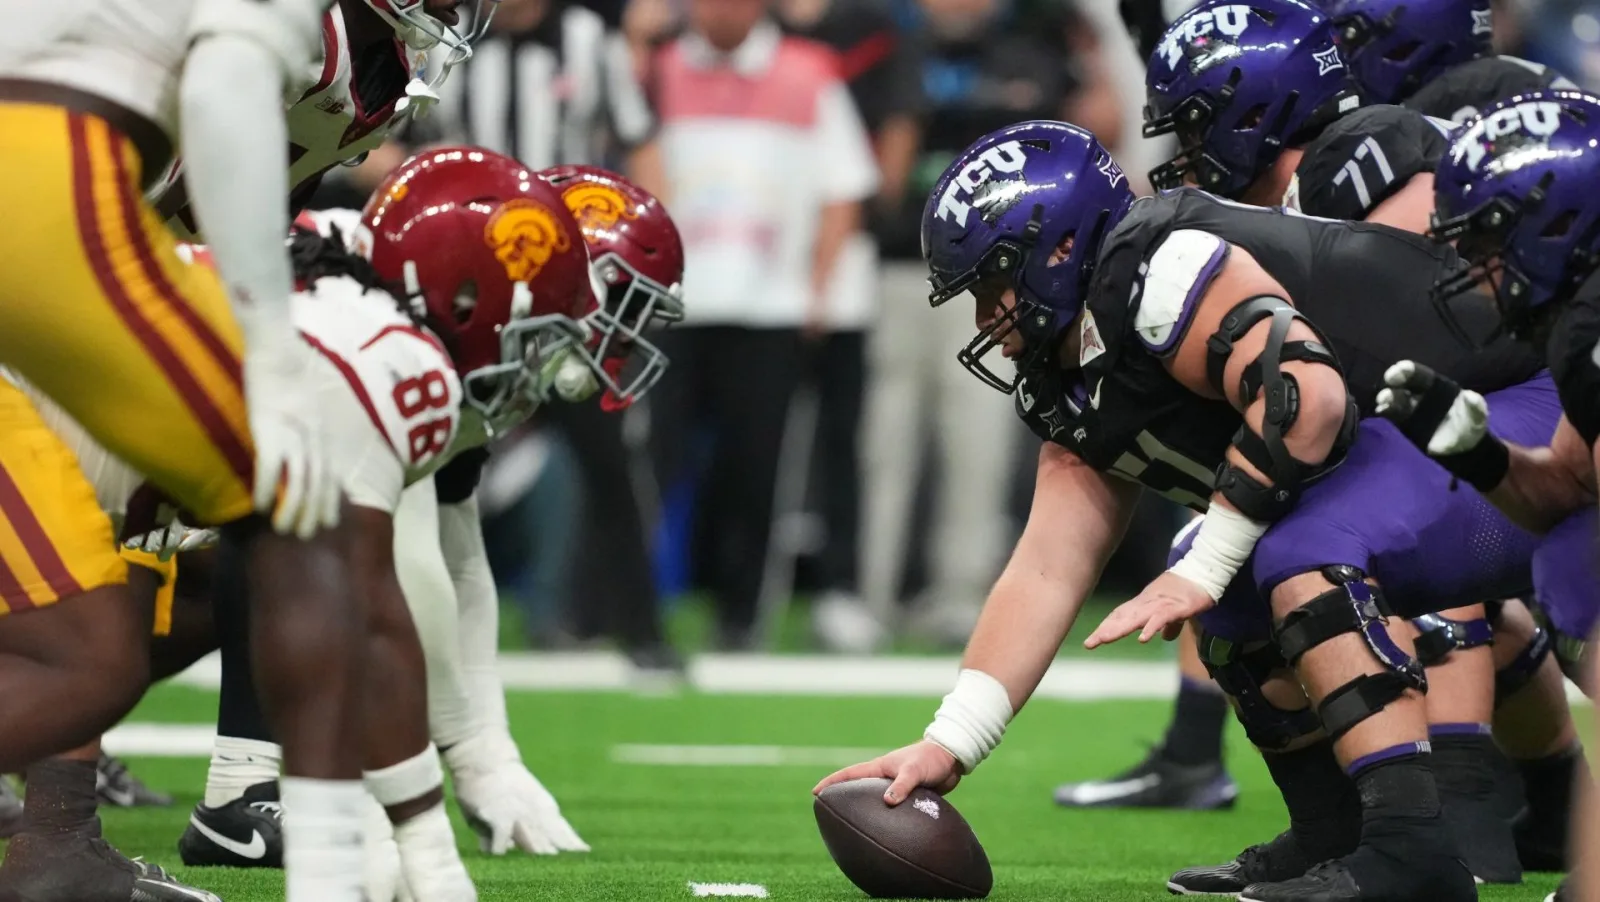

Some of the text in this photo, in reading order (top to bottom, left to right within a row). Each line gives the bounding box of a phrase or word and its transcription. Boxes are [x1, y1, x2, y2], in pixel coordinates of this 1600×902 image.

[1157, 5, 1249, 71] TCU
[1333, 136, 1394, 209] 77
[1451, 101, 1561, 172] TCU
[936, 140, 1027, 228] TCU
[392, 369, 451, 464] 88
